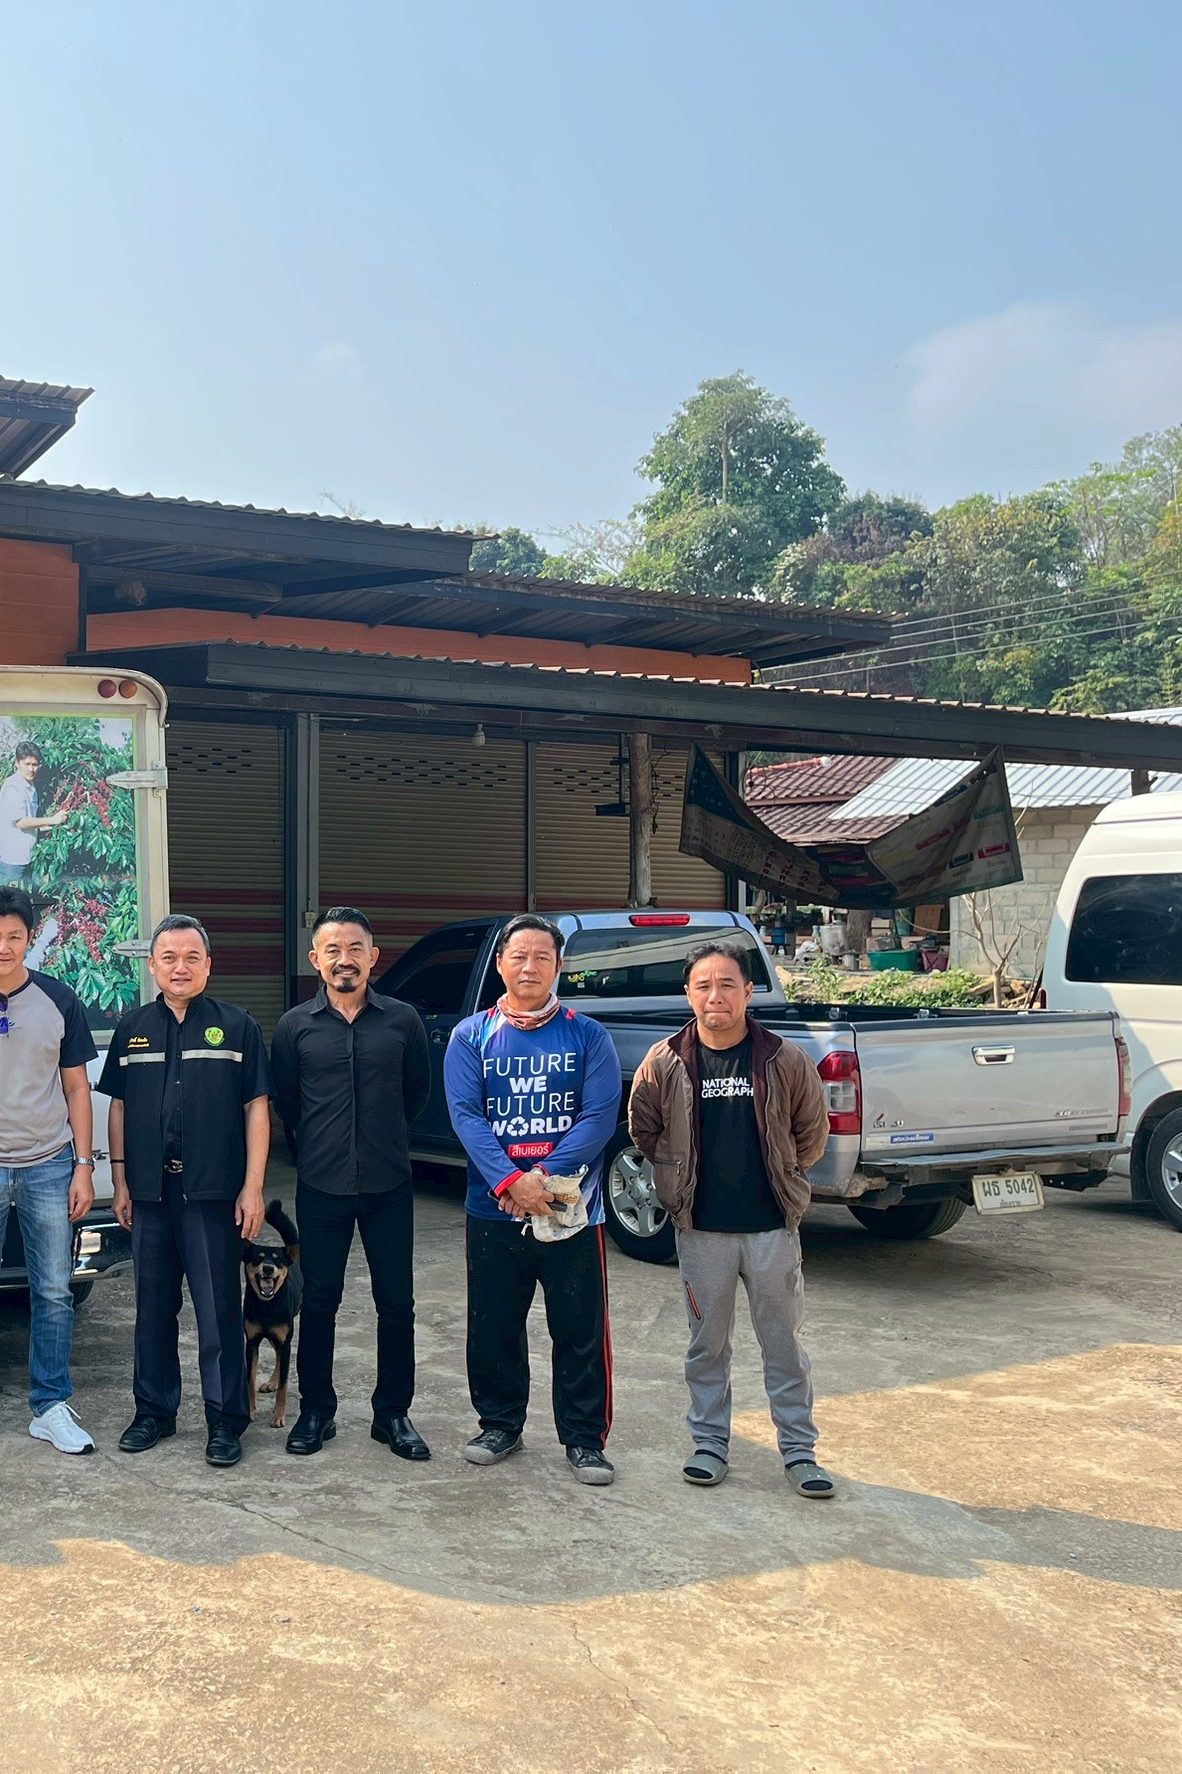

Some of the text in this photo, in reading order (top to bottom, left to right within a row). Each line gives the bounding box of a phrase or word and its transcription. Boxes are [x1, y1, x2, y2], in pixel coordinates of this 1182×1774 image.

[483, 1052, 577, 1078] FUTURE
[509, 1075, 548, 1093] WE
[702, 1076, 751, 1089] NATIONAL
[486, 1091, 575, 1117] FUTURE
[1005, 1178, 1035, 1195] 5042
